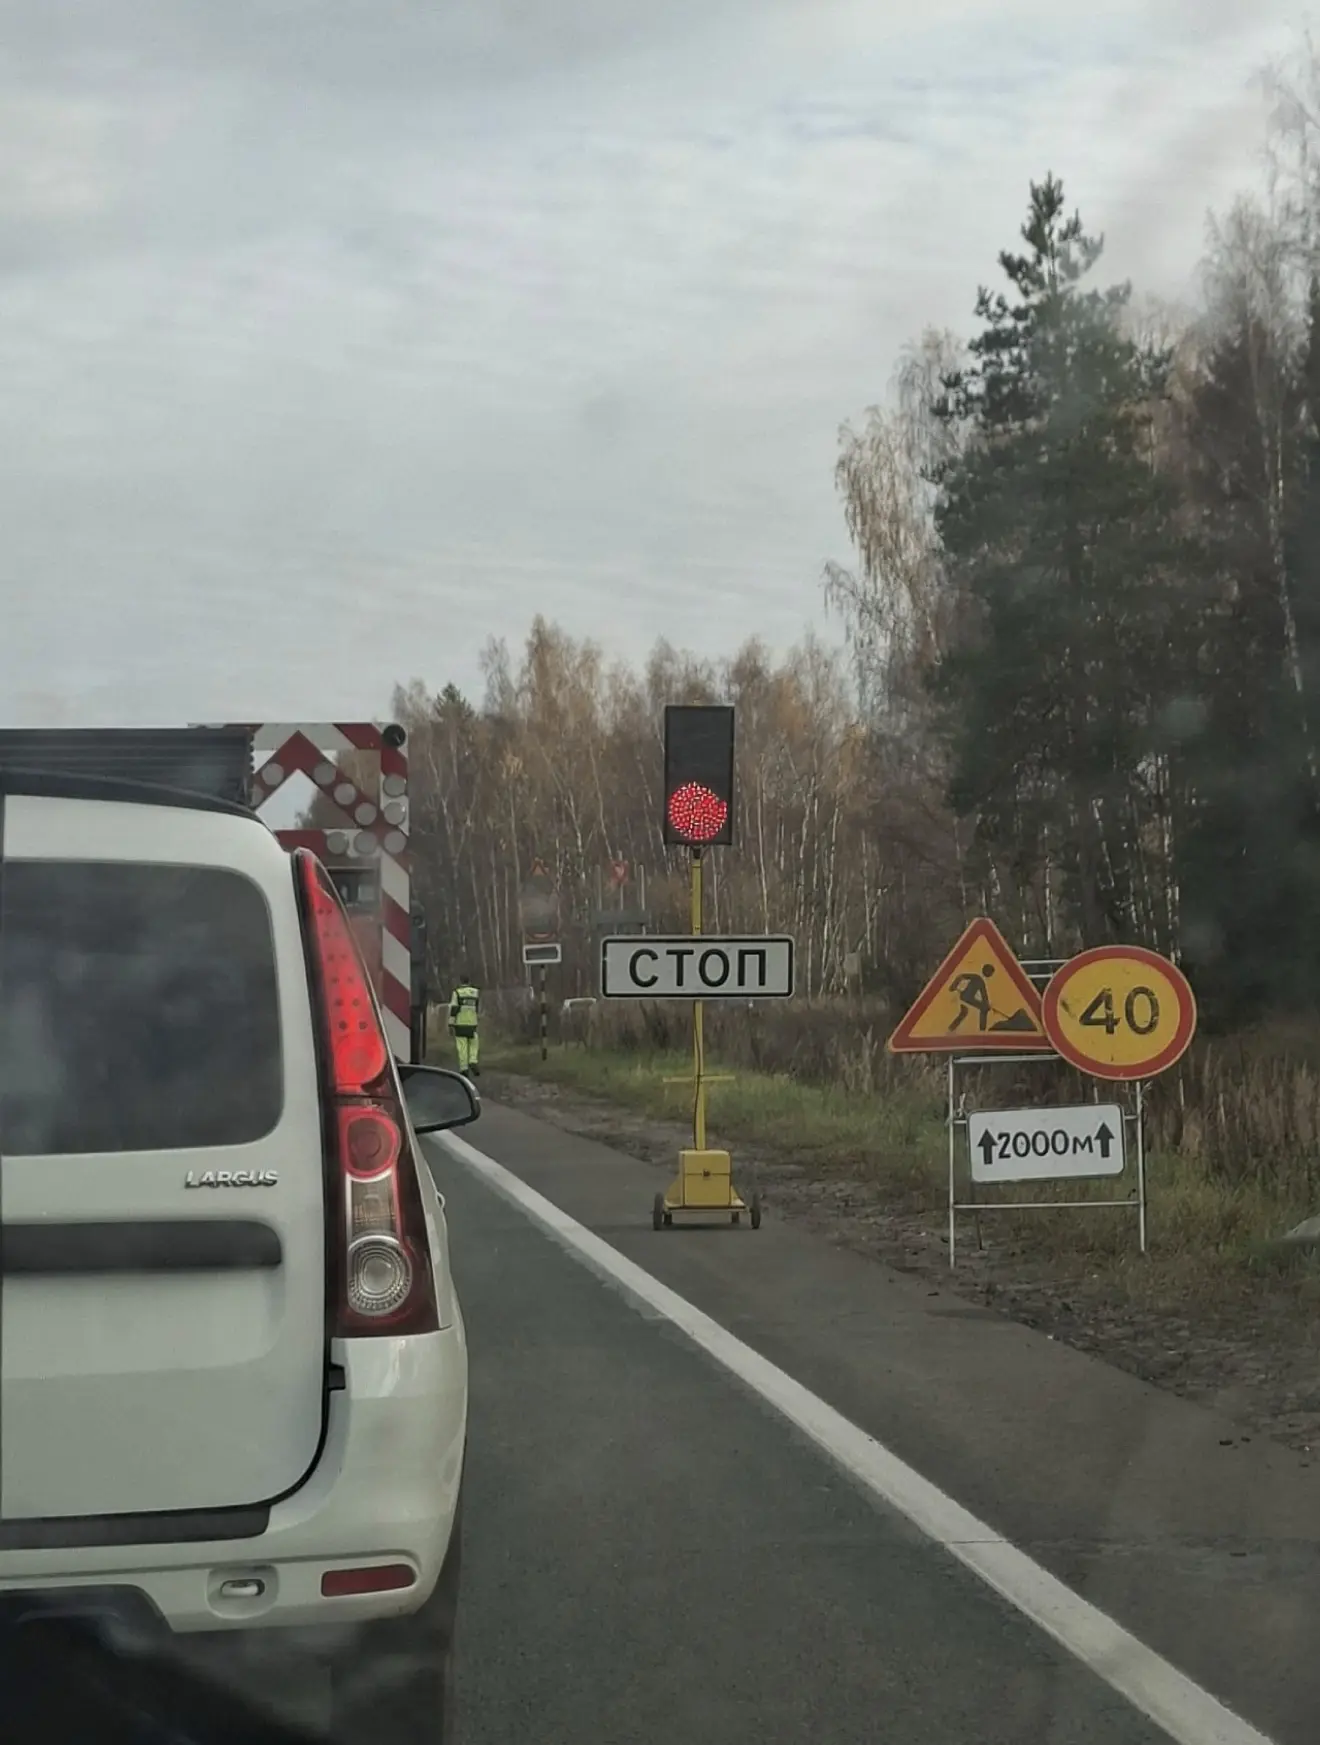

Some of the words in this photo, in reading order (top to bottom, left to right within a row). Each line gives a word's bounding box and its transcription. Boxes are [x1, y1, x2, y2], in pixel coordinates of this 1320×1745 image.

[629, 948, 766, 987] СТОП
[1079, 986, 1160, 1035] 40
[184, 1170, 279, 1189] LARGUS
